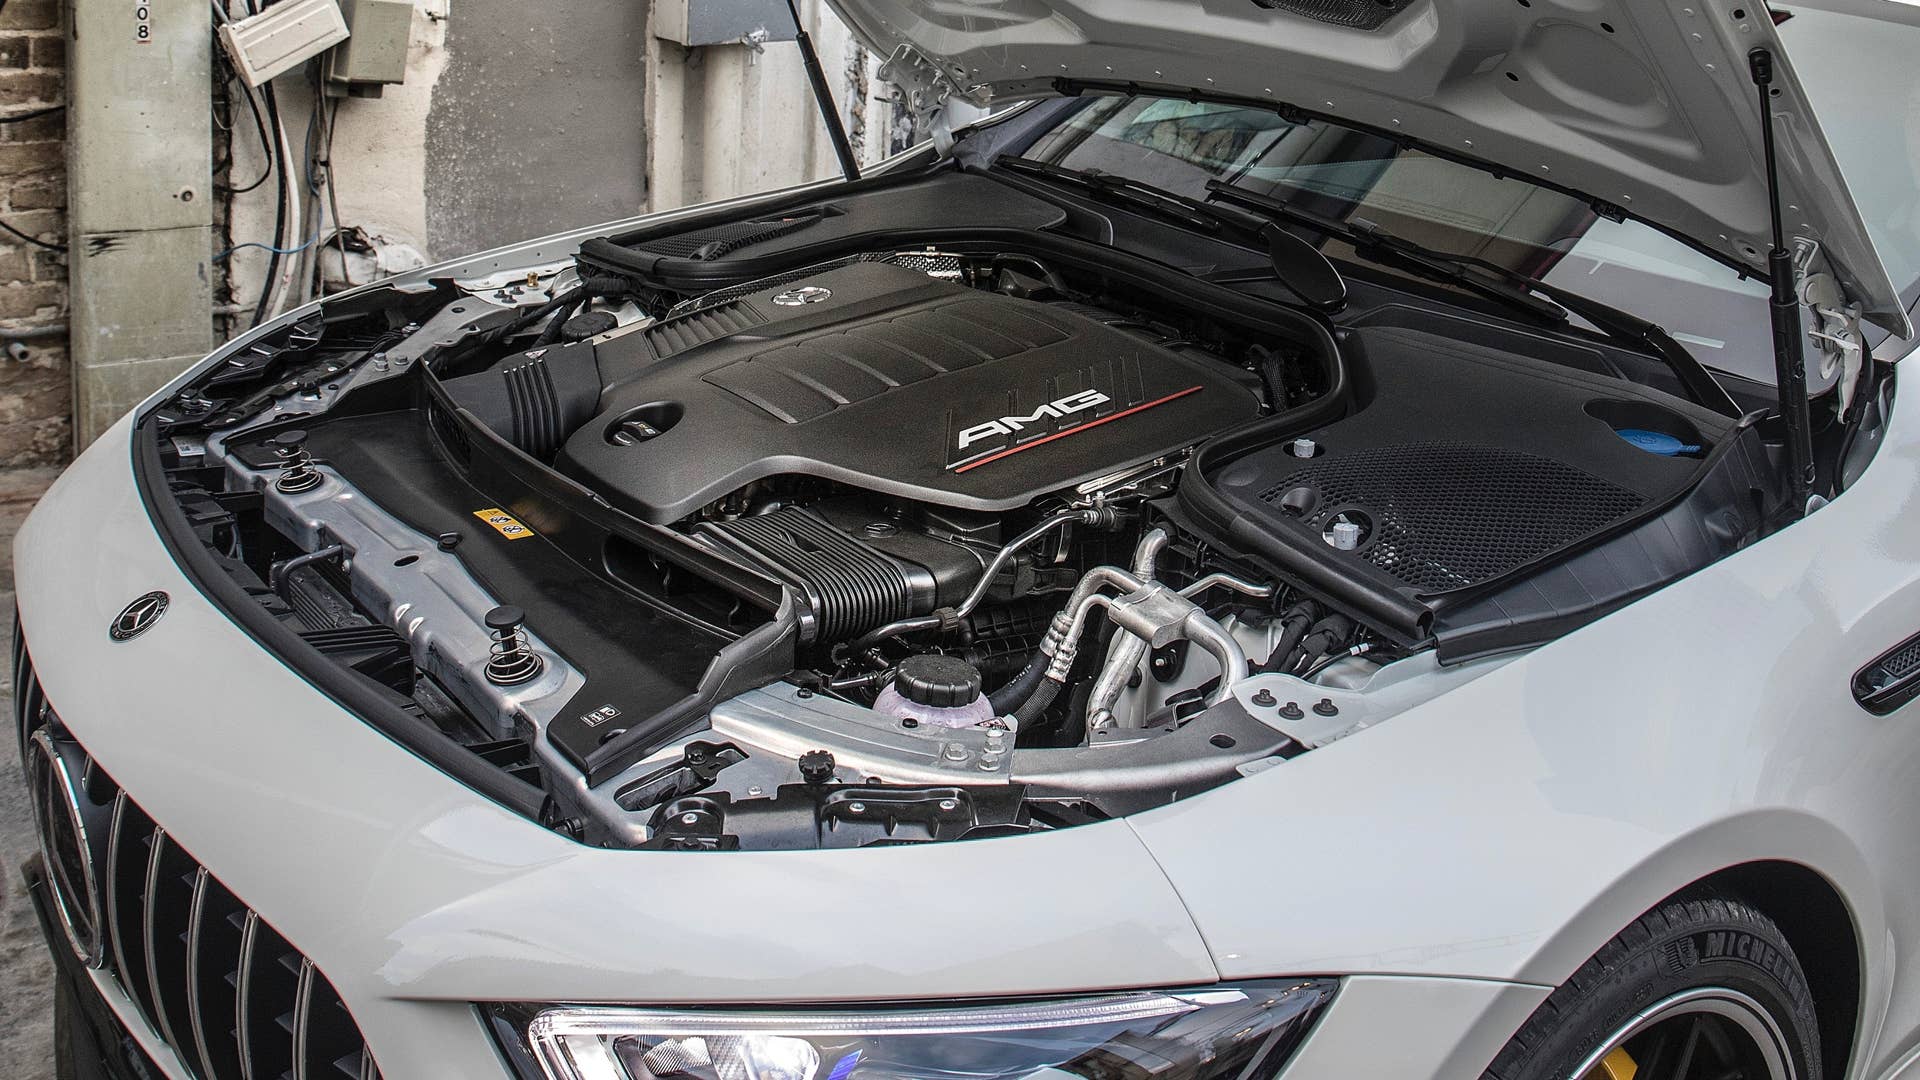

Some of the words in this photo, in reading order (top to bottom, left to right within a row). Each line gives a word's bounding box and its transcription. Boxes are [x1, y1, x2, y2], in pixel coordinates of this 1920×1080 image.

[137, 0, 149, 39] 08
[958, 388, 1111, 450] AMG
[1705, 931, 1803, 1003] MICHELIN
